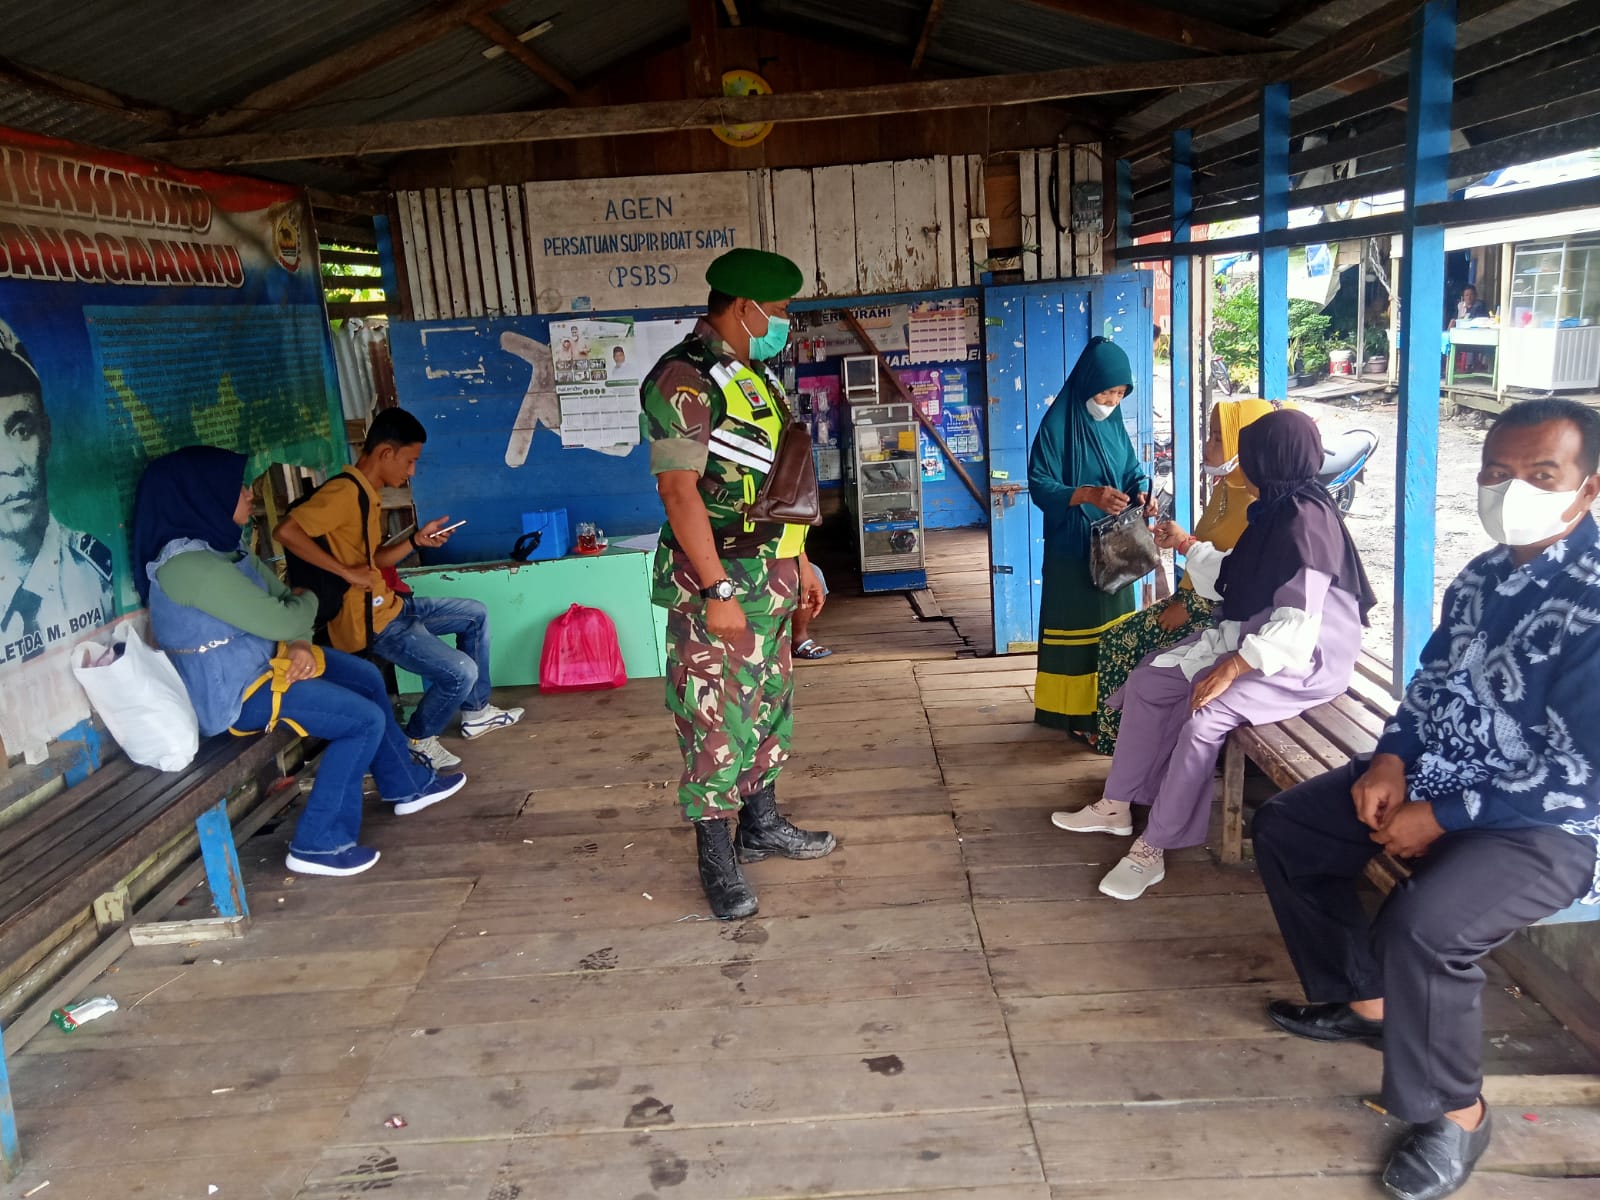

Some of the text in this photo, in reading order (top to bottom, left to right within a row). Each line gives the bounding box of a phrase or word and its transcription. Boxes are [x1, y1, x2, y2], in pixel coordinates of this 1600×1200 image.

[605, 196, 674, 221] AGEN
[543, 233, 619, 257] PERSATUAN
[620, 232, 659, 252] SUPIR
[661, 230, 692, 250] BOAT
[608, 263, 678, 289] (PSBS)
[46, 624, 66, 642] M.
[69, 608, 101, 633] BOYA
